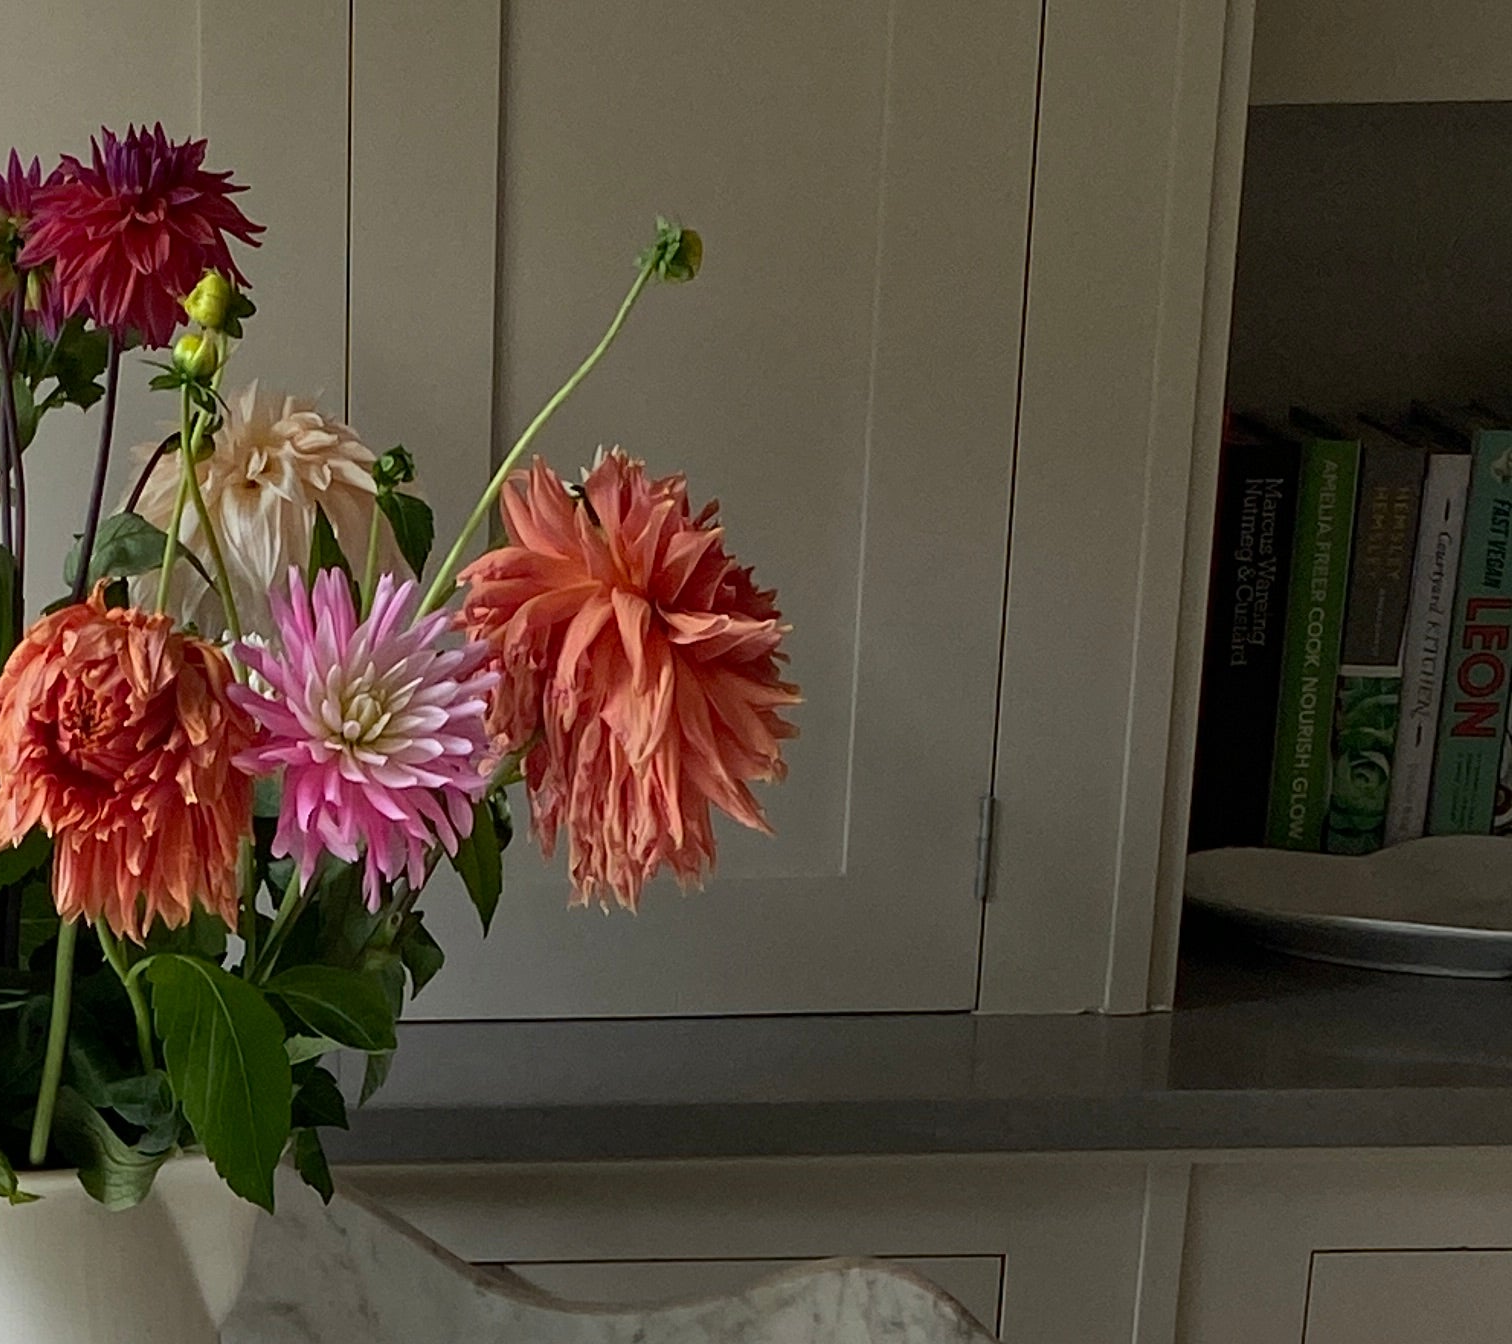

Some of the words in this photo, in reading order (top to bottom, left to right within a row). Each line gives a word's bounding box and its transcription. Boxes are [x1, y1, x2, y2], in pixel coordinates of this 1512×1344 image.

[1234, 478, 1263, 558] Nutmeg
[1258, 478, 1284, 555] Marcus
[1315, 459, 1337, 536] AMELIA
[1490, 499, 1512, 538] FAST
[1238, 565, 1255, 582] &
[1250, 557, 1277, 647] Wareing
[1310, 542, 1332, 602] FREER
[1426, 531, 1453, 615] Courtyard
[1482, 541, 1506, 589] VEGAN
[1228, 584, 1254, 668] Custard
[1450, 597, 1512, 738] LEON
